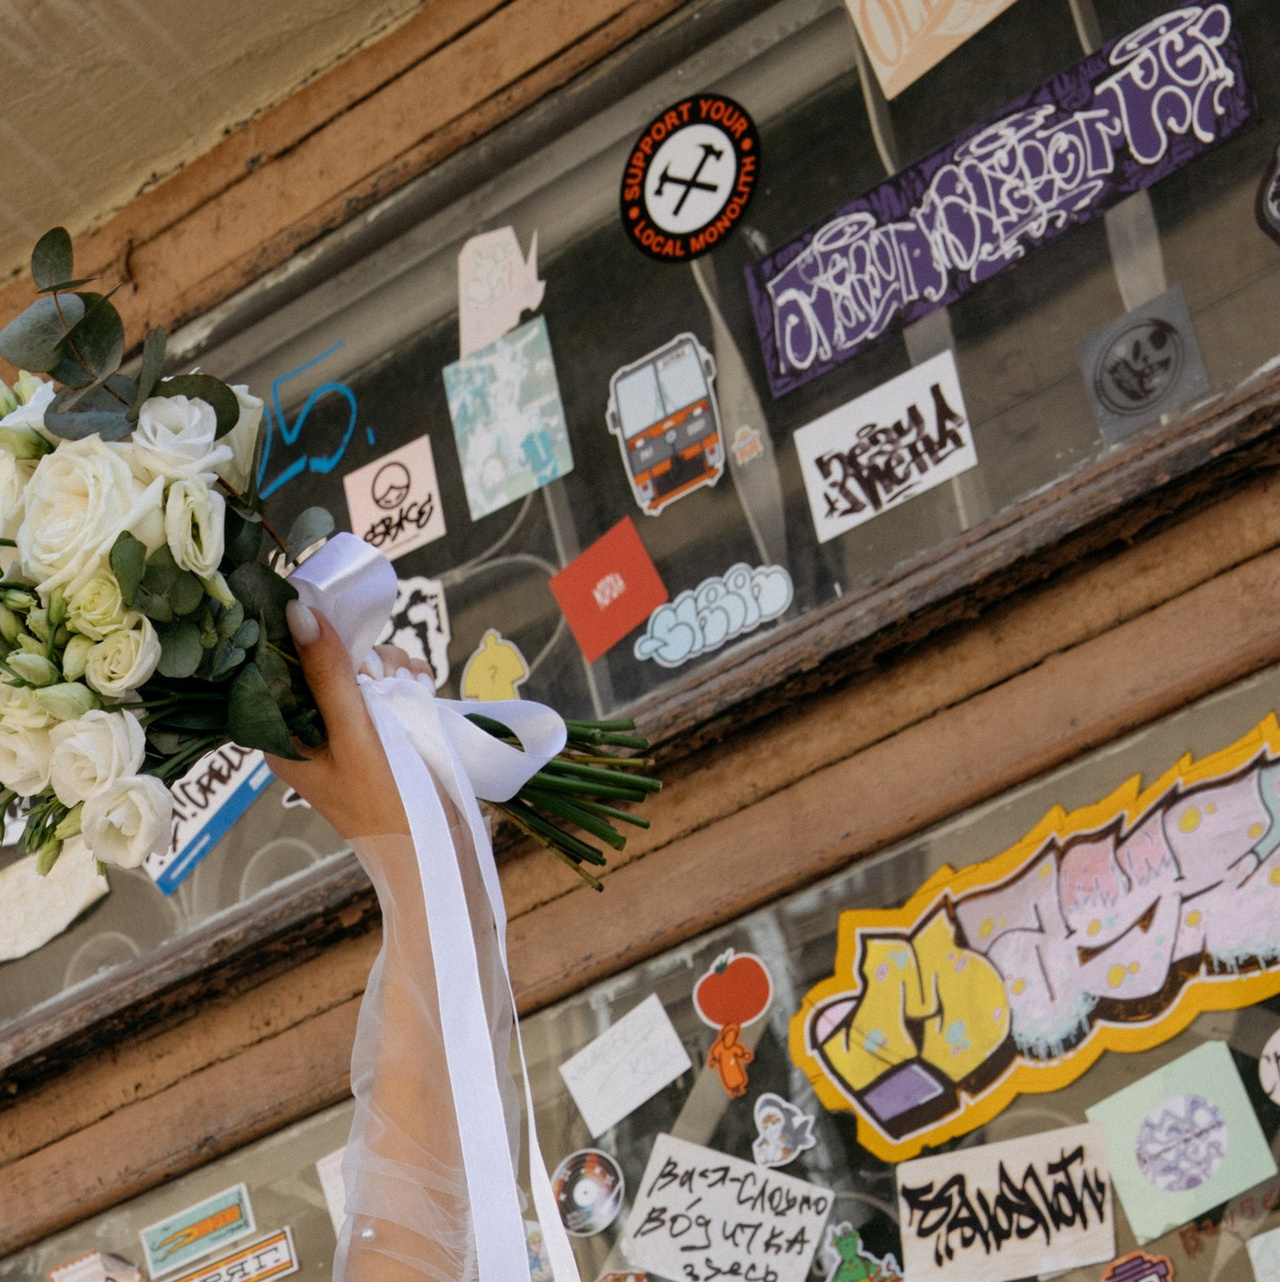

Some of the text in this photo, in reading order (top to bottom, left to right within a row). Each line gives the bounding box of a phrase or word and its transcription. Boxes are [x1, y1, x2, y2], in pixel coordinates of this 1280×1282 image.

[624, 99, 749, 202] SUPPORT YOUR
[633, 155, 757, 257] LOCAL MONOLITH
